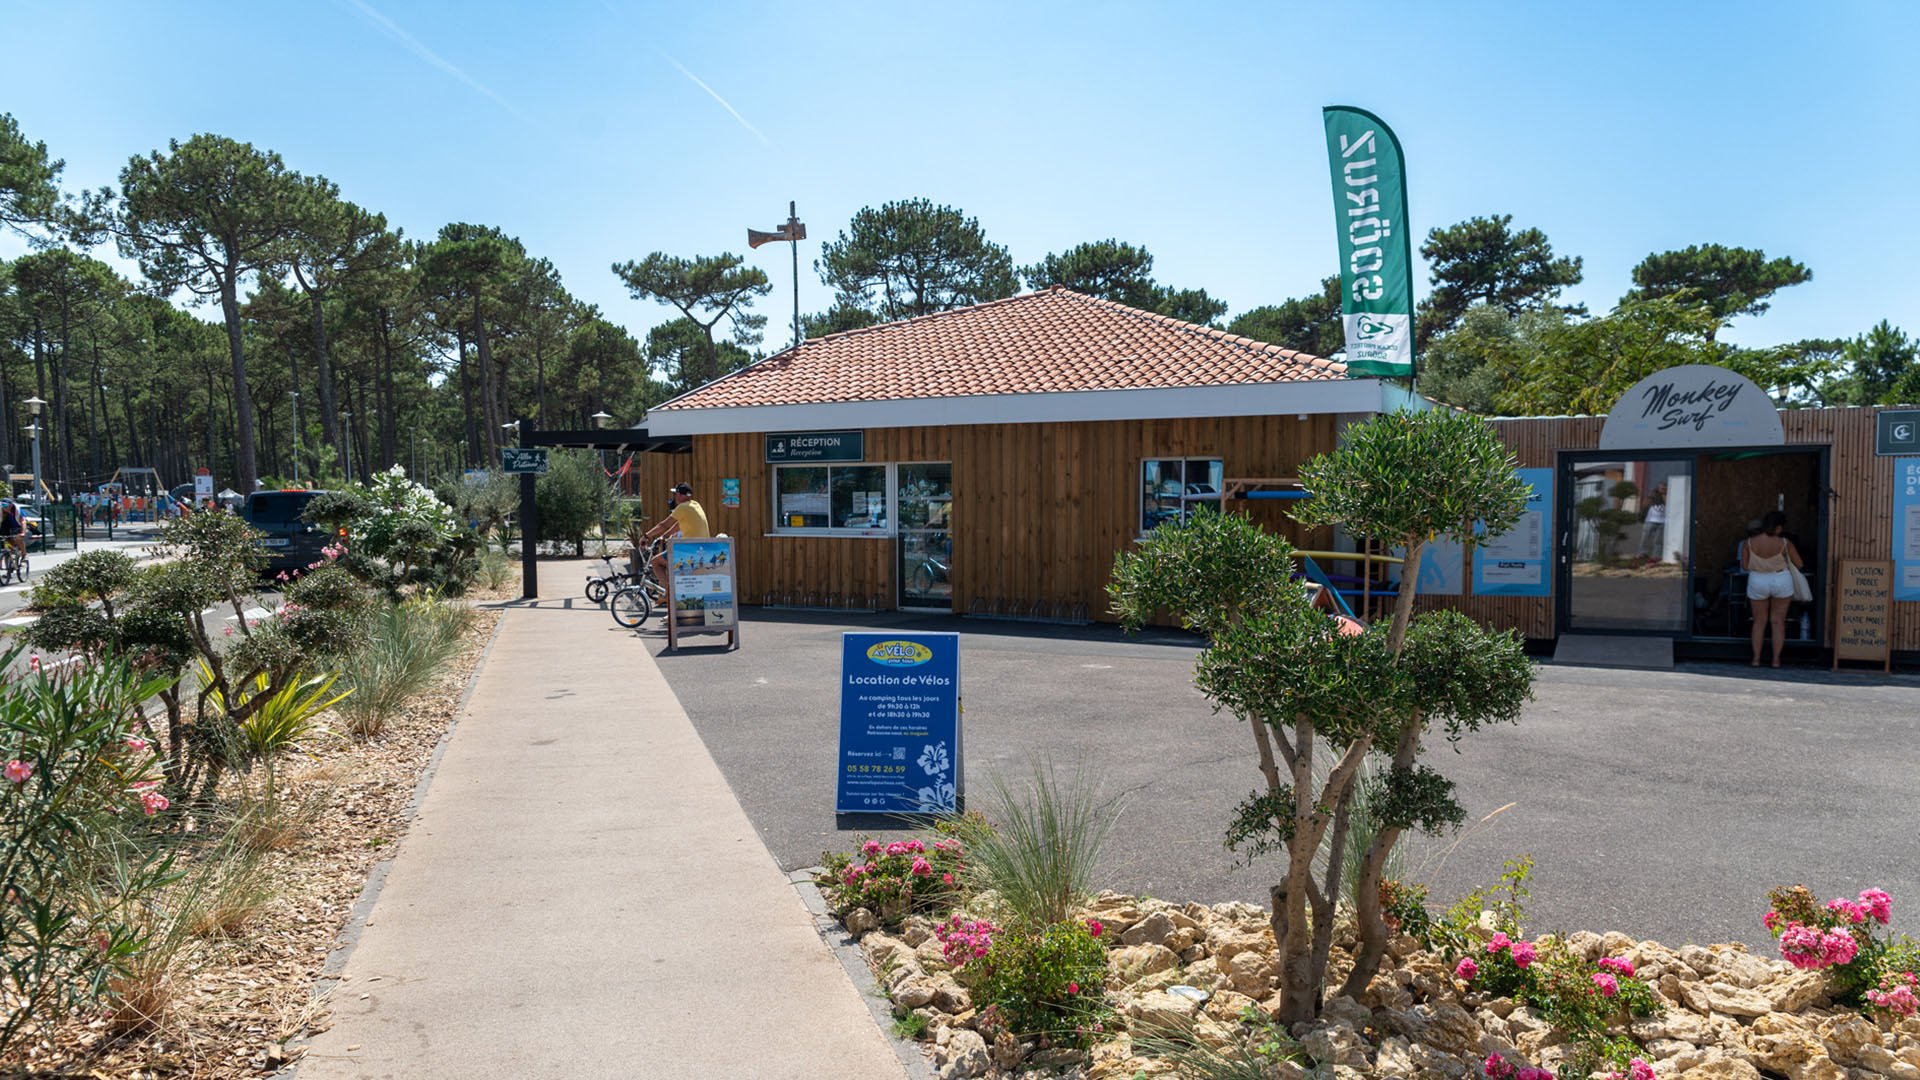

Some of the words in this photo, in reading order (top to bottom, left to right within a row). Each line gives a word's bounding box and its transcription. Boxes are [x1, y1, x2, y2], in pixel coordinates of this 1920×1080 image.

[1642, 380, 1744, 418] Monkey
[1657, 404, 1715, 431] Surf
[790, 436, 841, 447] RÉCEPTION
[790, 448, 822, 458] Reception
[1906, 486, 1916, 496] &
[1850, 567, 1884, 576] LOCATION
[885, 643, 915, 656] VÉLO
[849, 675, 900, 685] Location
[902, 675, 917, 685] de
[919, 674, 950, 685] Vélos
[872, 765, 881, 773] 78
[883, 765, 893, 773] 26
[896, 765, 906, 773] 59
